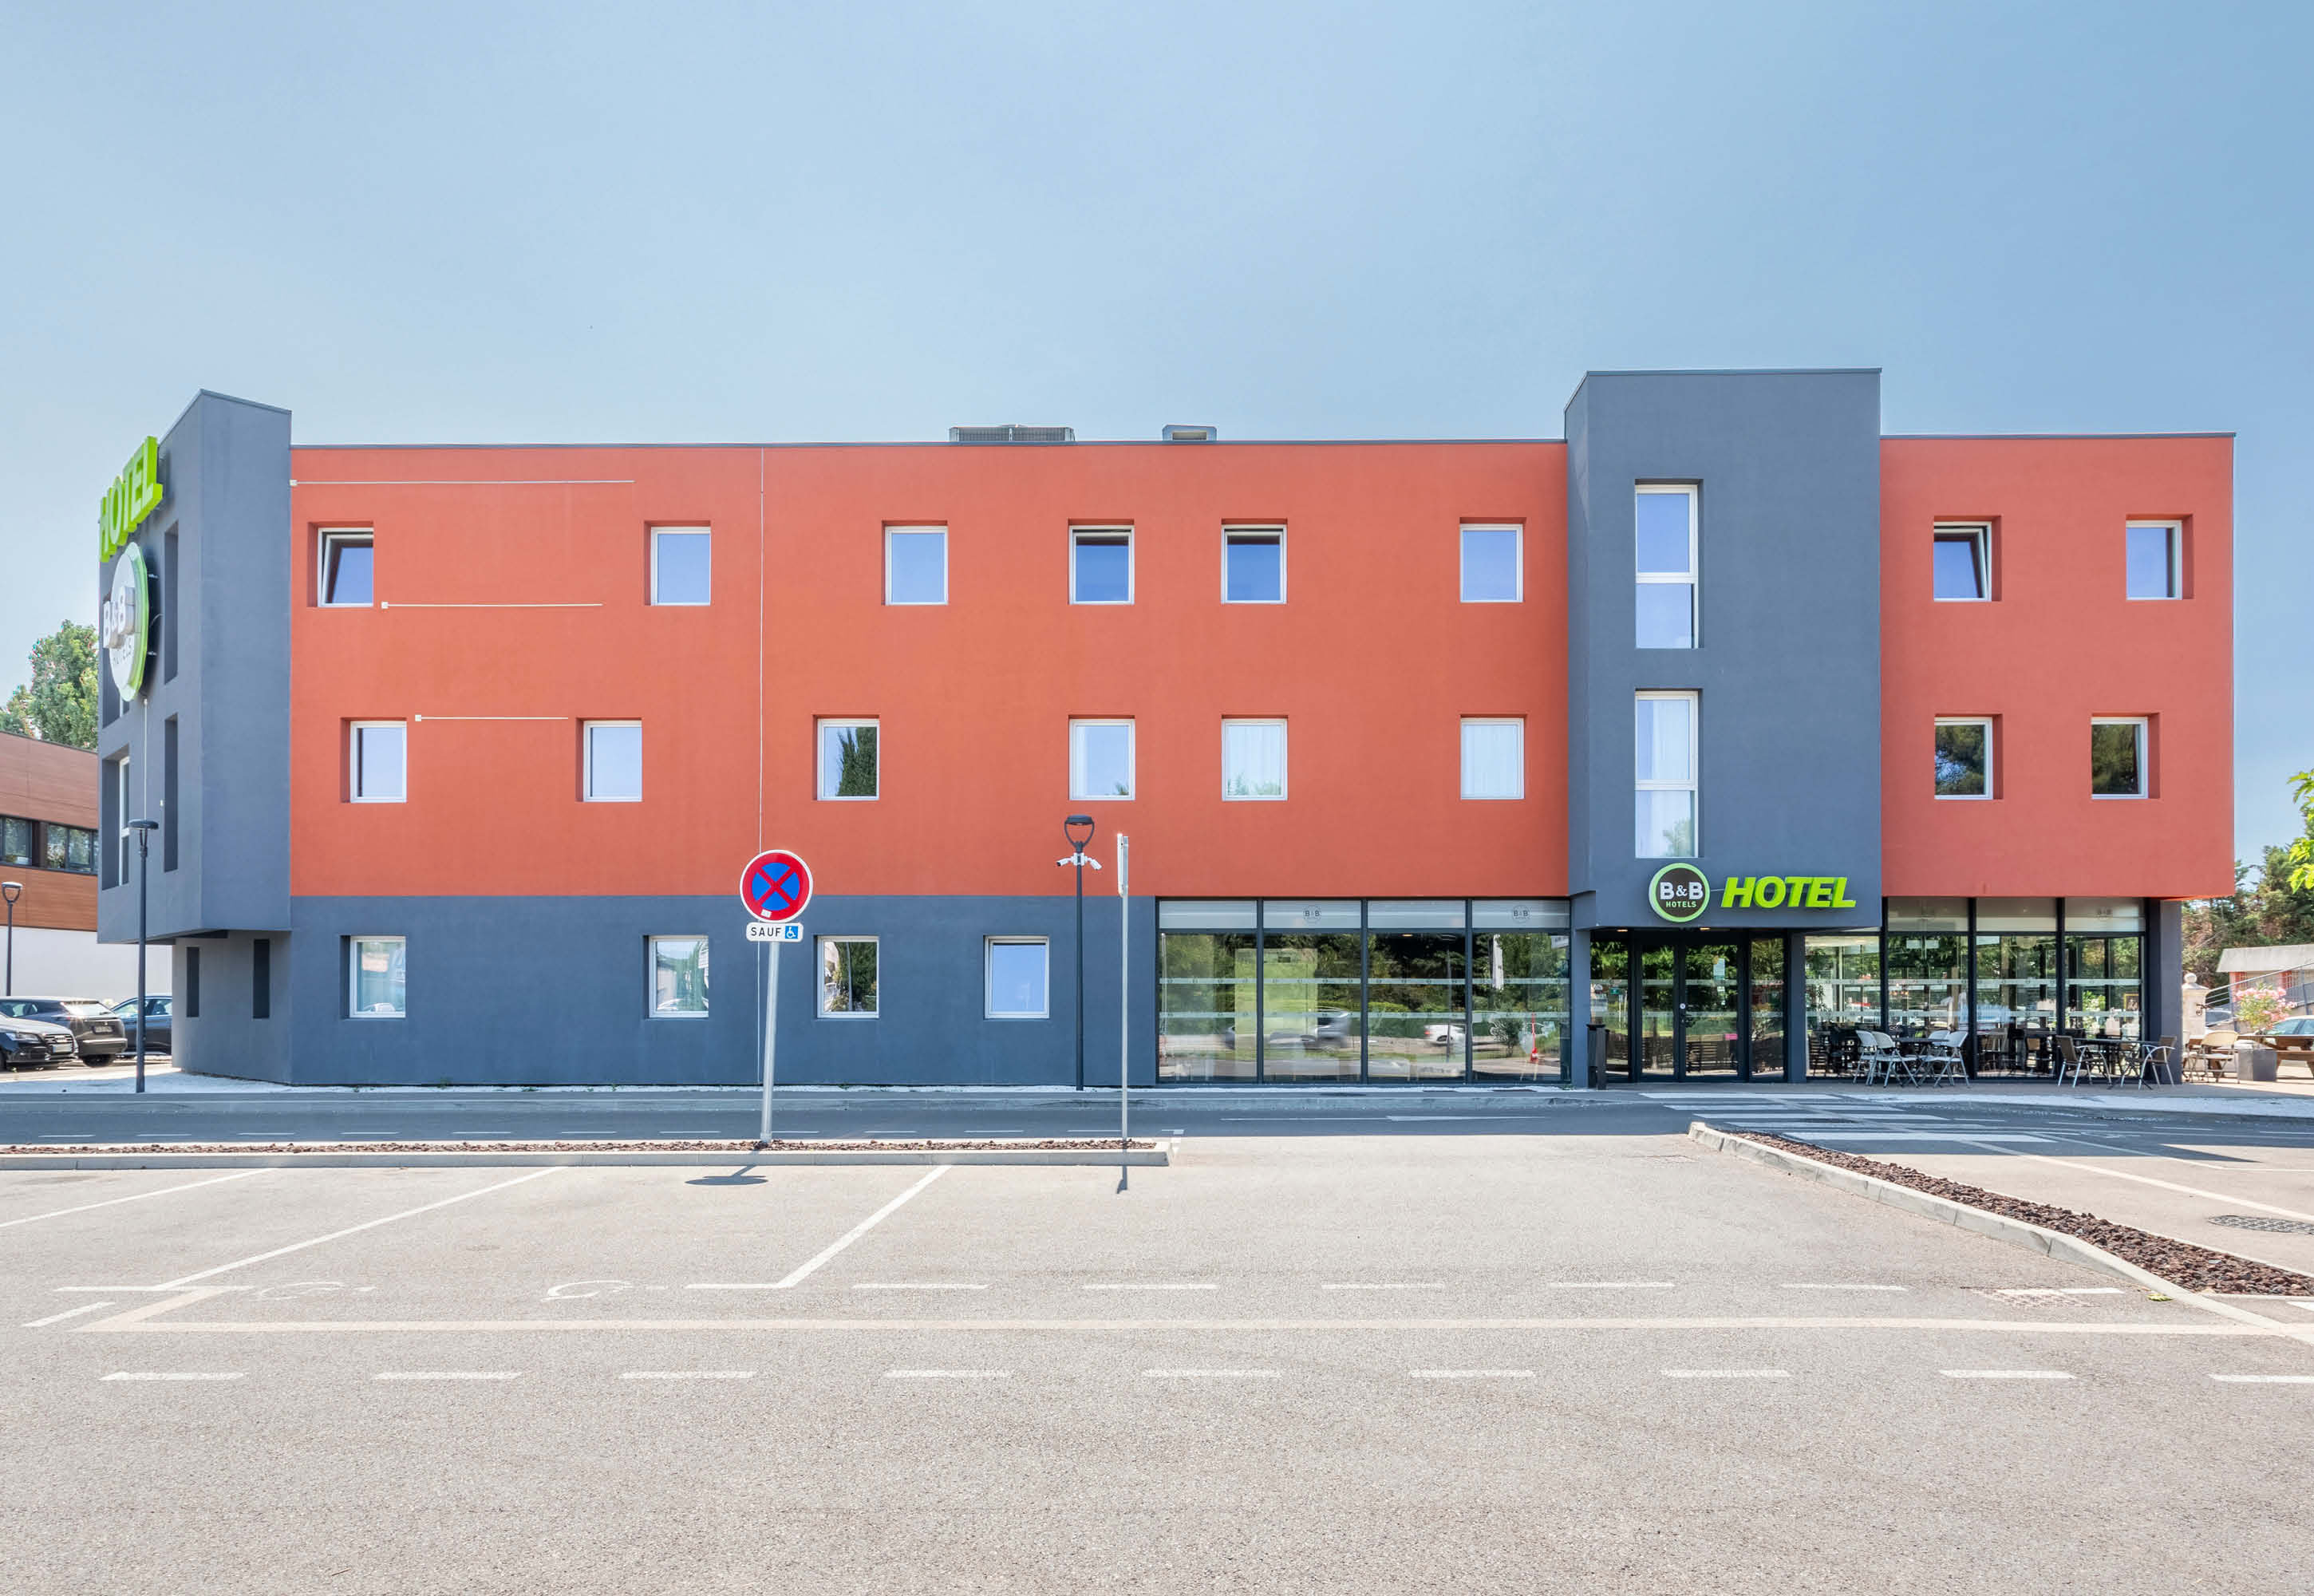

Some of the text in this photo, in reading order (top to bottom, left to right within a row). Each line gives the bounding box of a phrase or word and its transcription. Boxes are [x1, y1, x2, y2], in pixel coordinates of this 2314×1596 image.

[100, 436, 163, 562] HOTEL
[1660, 882, 1704, 899] B&B
[1720, 876, 1857, 908] HOTEL
[751, 926, 781, 937] SAUF
